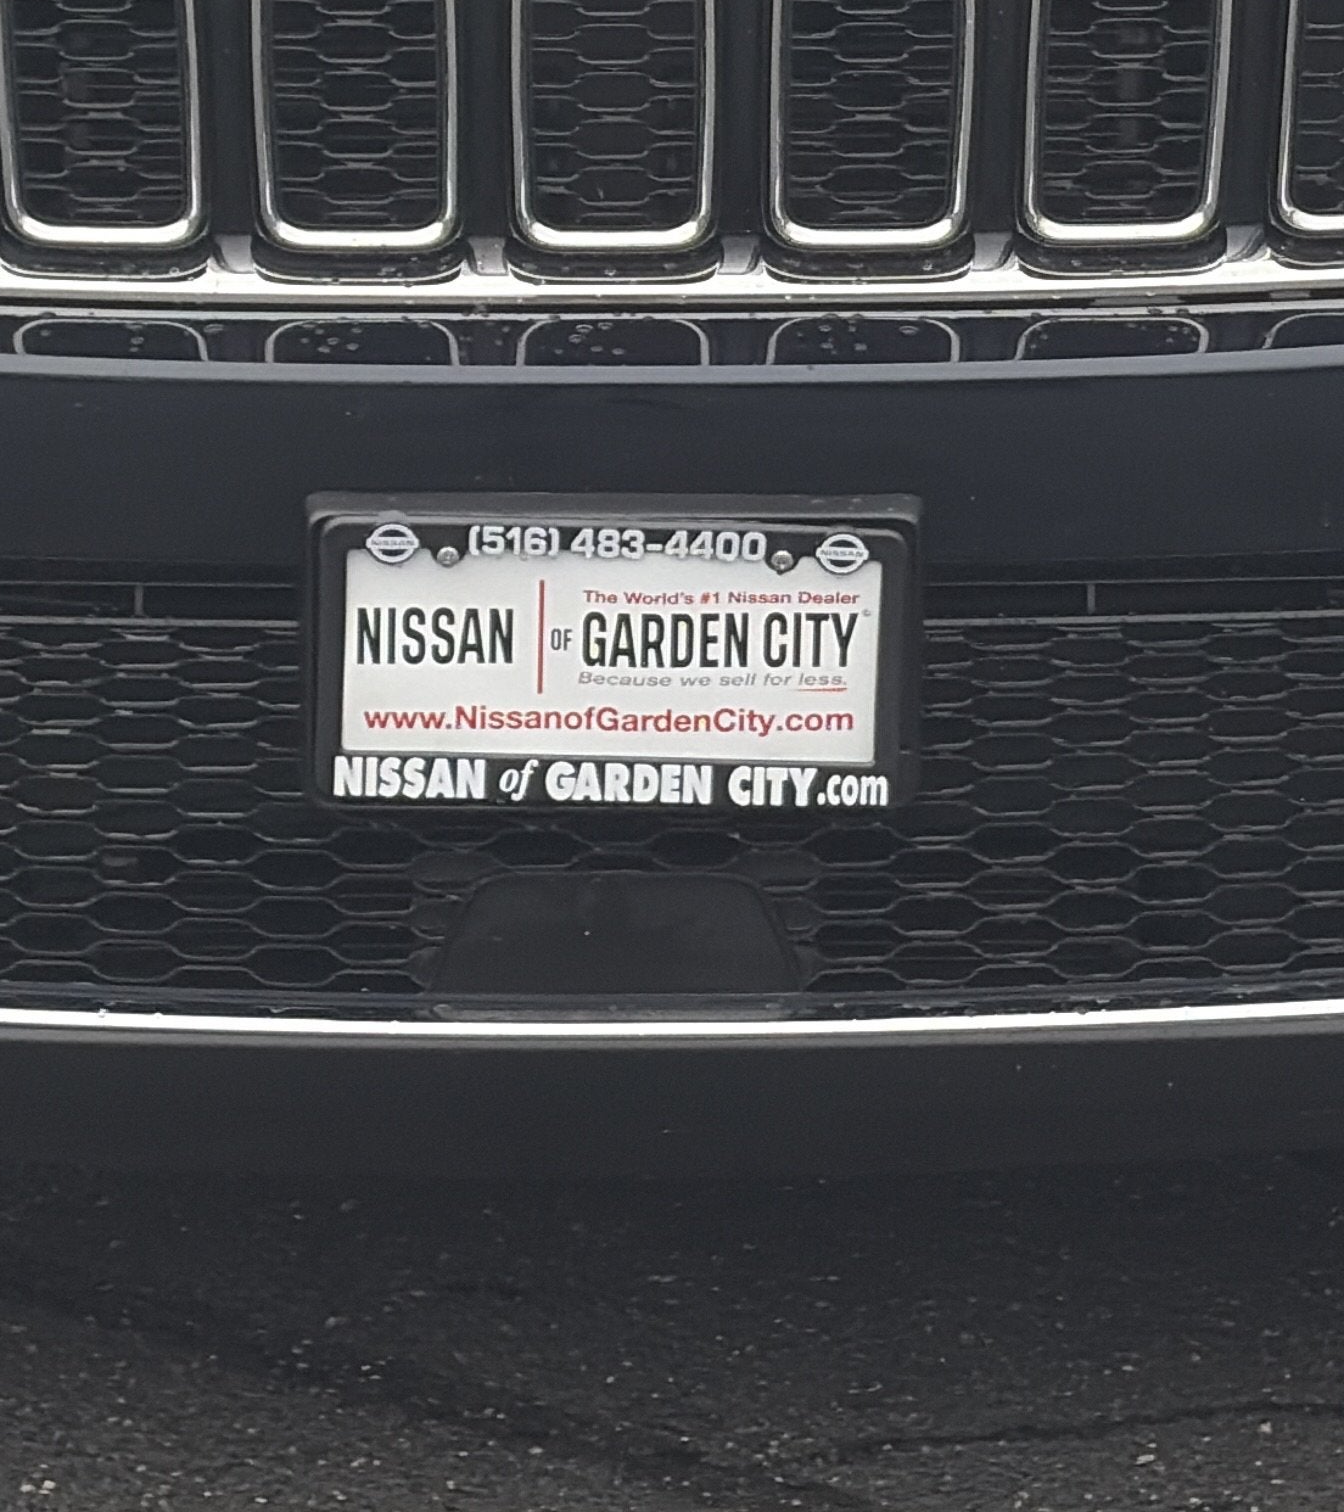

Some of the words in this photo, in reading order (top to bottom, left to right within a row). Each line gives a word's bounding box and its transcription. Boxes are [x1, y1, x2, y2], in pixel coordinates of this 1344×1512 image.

[468, 525, 560, 556] (516)
[570, 528, 768, 562] 483-4400
[583, 590, 618, 605] The
[623, 591, 694, 605] World's
[700, 591, 719, 605] #1
[728, 591, 792, 605] Nissan
[798, 591, 860, 605] Dealer
[356, 607, 514, 665] NISSAN
[550, 628, 573, 651] OF
[582, 611, 749, 668] GARDEN
[762, 611, 859, 668] CITY
[578, 671, 671, 686] Because
[680, 674, 711, 686] we
[719, 672, 756, 686] sell
[763, 672, 793, 686] for
[798, 672, 848, 686] less.
[363, 705, 854, 737] www.NissanofGardenCity.com
[333, 755, 486, 800] NISSAN
[498, 759, 539, 802] of
[544, 761, 713, 805] GARDEN
[728, 765, 888, 807] CITY.com
